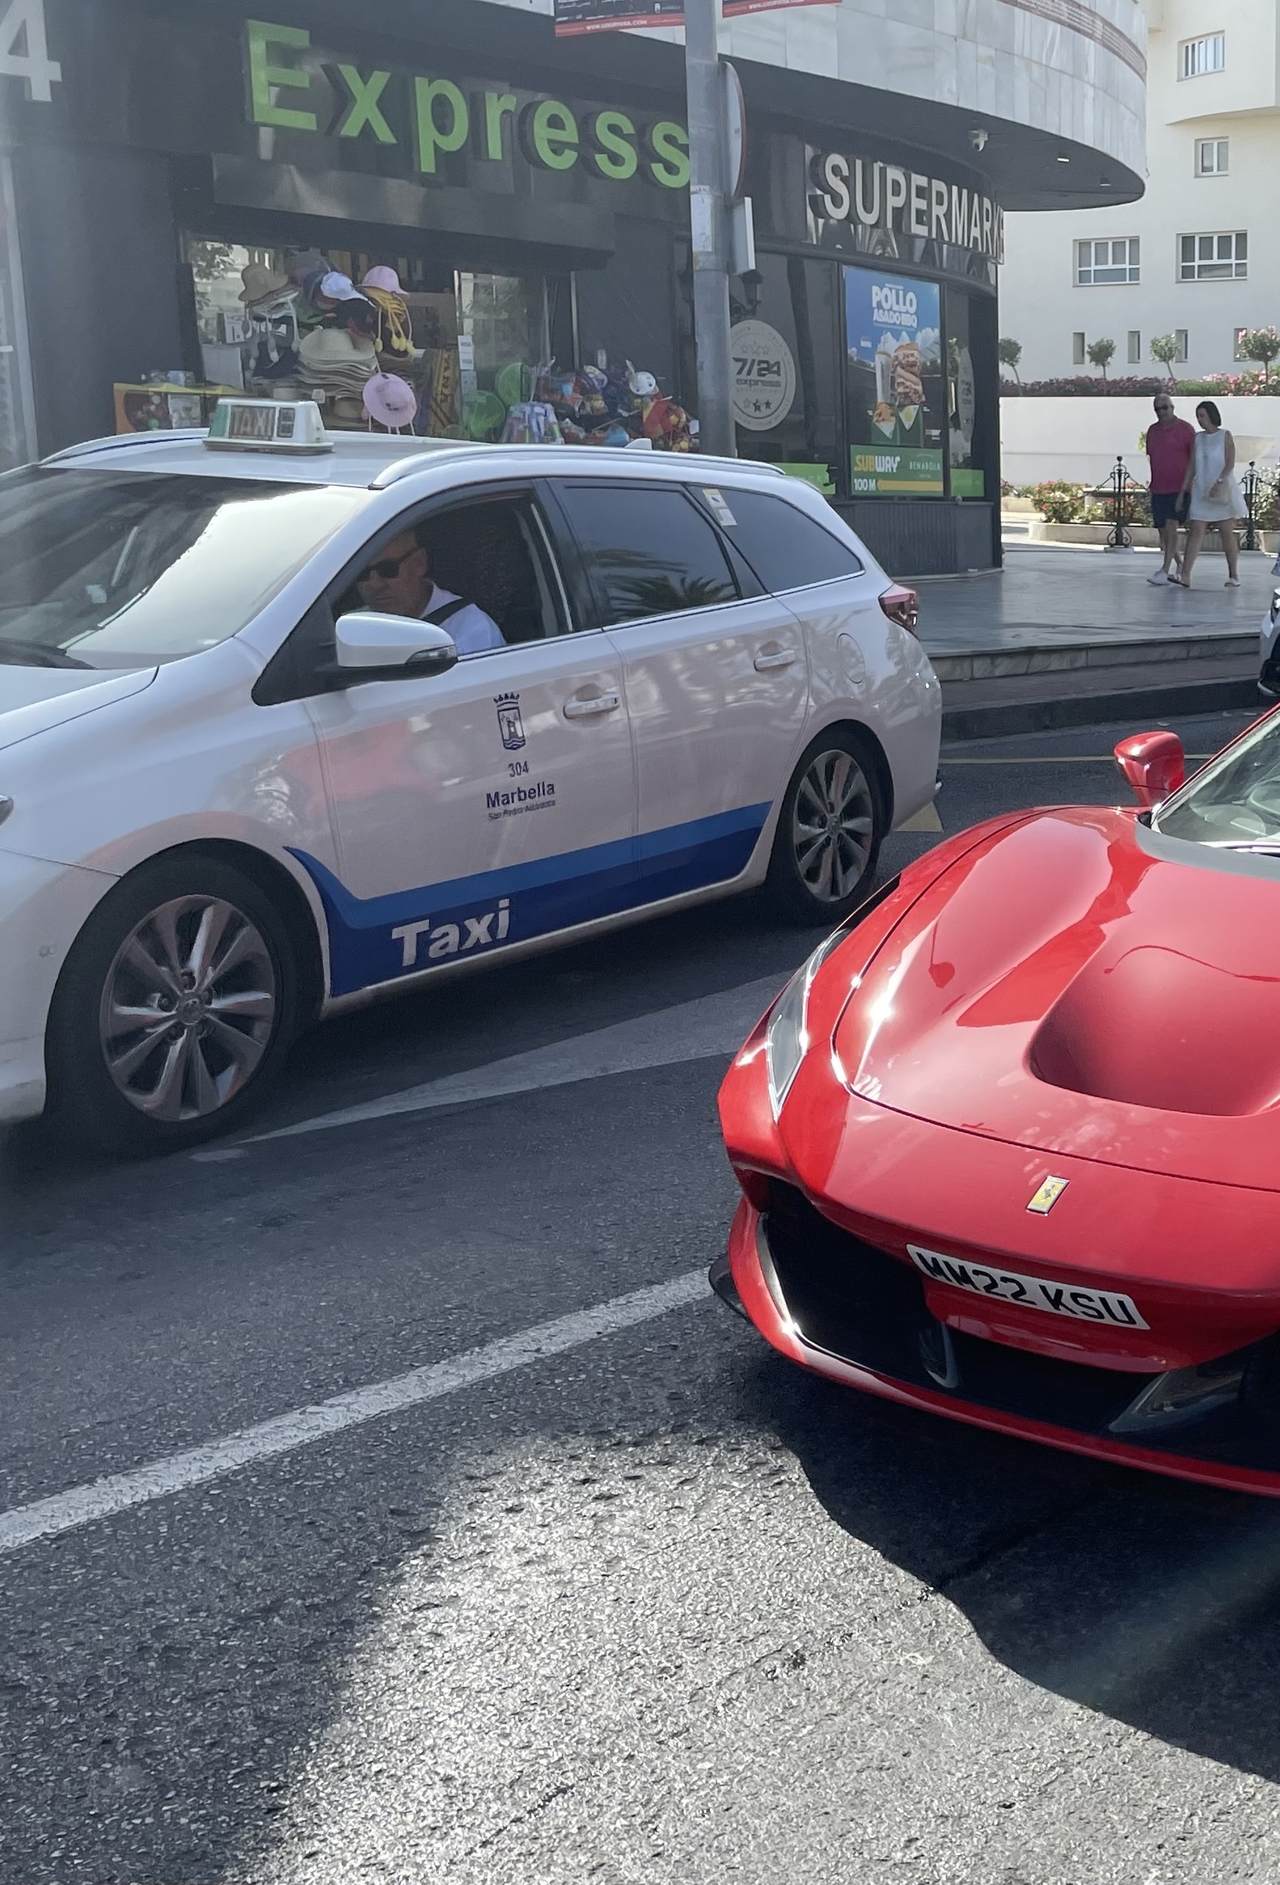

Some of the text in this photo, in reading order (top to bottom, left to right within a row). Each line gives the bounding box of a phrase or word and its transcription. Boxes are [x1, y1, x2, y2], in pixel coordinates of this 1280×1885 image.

[247, 20, 691, 188] Express
[872, 285, 917, 314] POLLO
[873, 308, 900, 325] ASADO
[732, 357, 781, 377] 7/24
[736, 378, 782, 388] express
[232, 407, 276, 436] TAXI
[854, 454, 901, 473] SUBWAY
[854, 478, 868, 491] 100
[508, 761, 529, 778] 304
[486, 781, 555, 808] Marbella
[392, 898, 511, 967] Taxi
[1039, 1285, 1137, 1325] KSU
